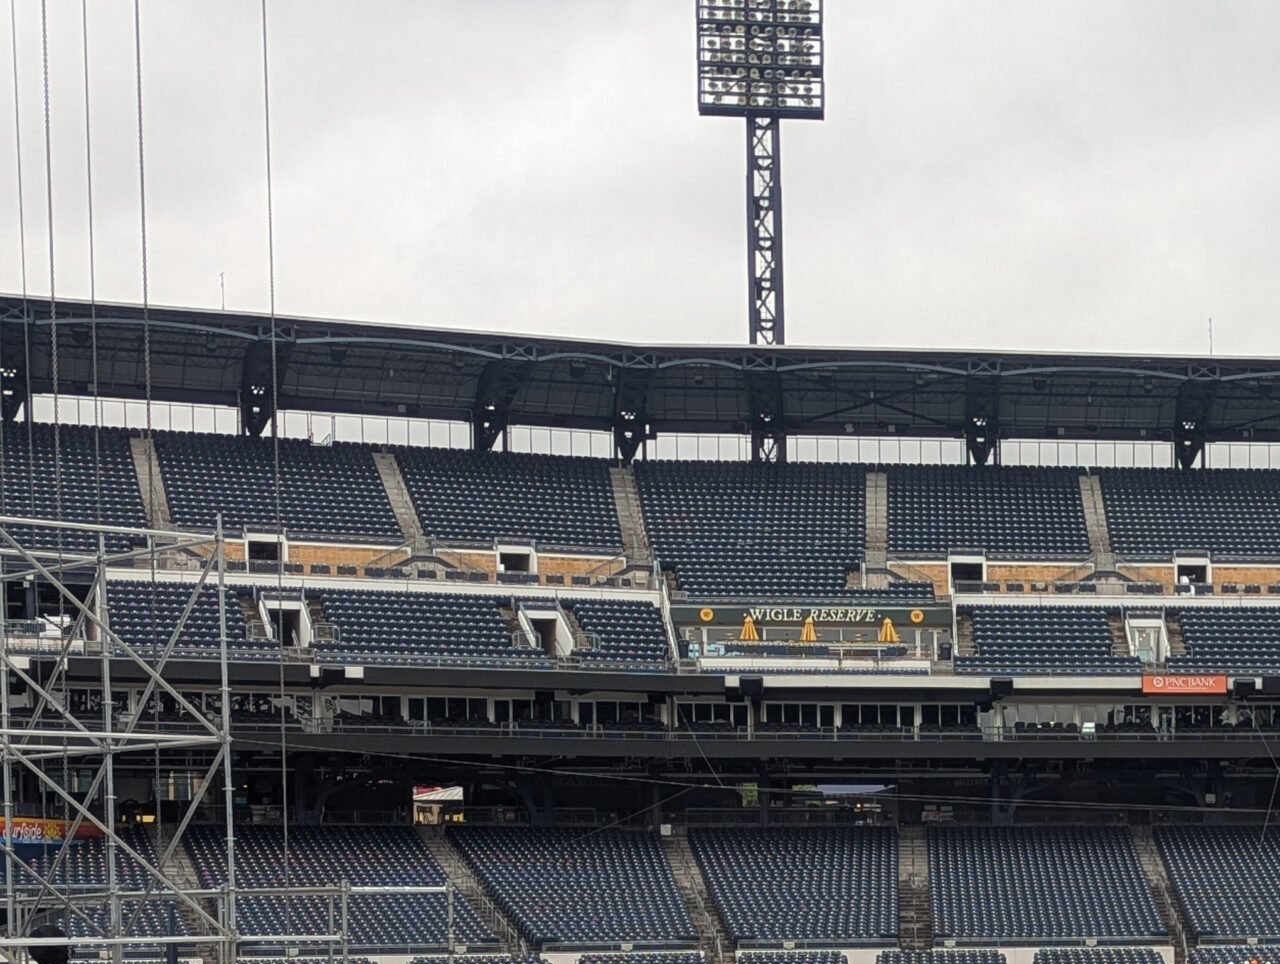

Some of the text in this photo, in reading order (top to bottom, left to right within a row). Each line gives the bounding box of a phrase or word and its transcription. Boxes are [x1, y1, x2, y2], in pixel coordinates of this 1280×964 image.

[749, 608, 876, 622] WIGLE RESERVE
[1165, 676, 1216, 687] PNC BANK
